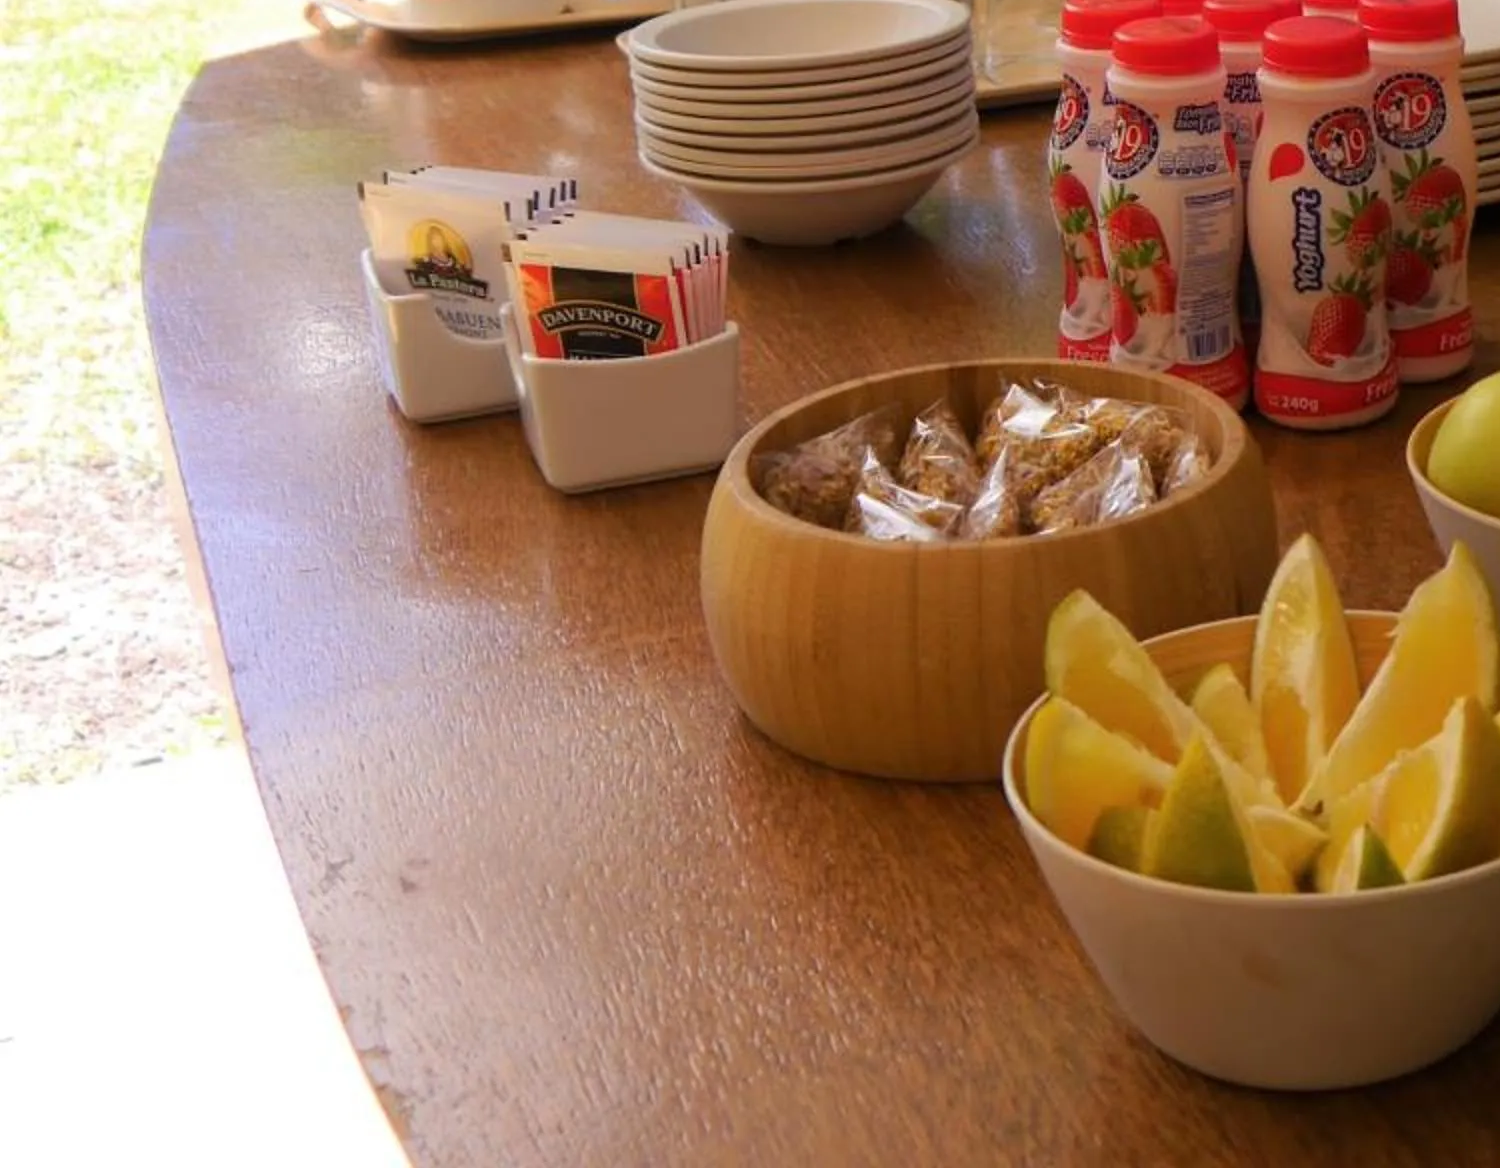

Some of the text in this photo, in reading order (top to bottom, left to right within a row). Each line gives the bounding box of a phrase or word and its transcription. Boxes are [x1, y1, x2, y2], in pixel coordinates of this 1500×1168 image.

[1400, 93, 1432, 132] 19
[1341, 127, 1367, 168] 19
[1294, 190, 1322, 290] Yoghurt
[541, 307, 658, 336] DAVENPORT
